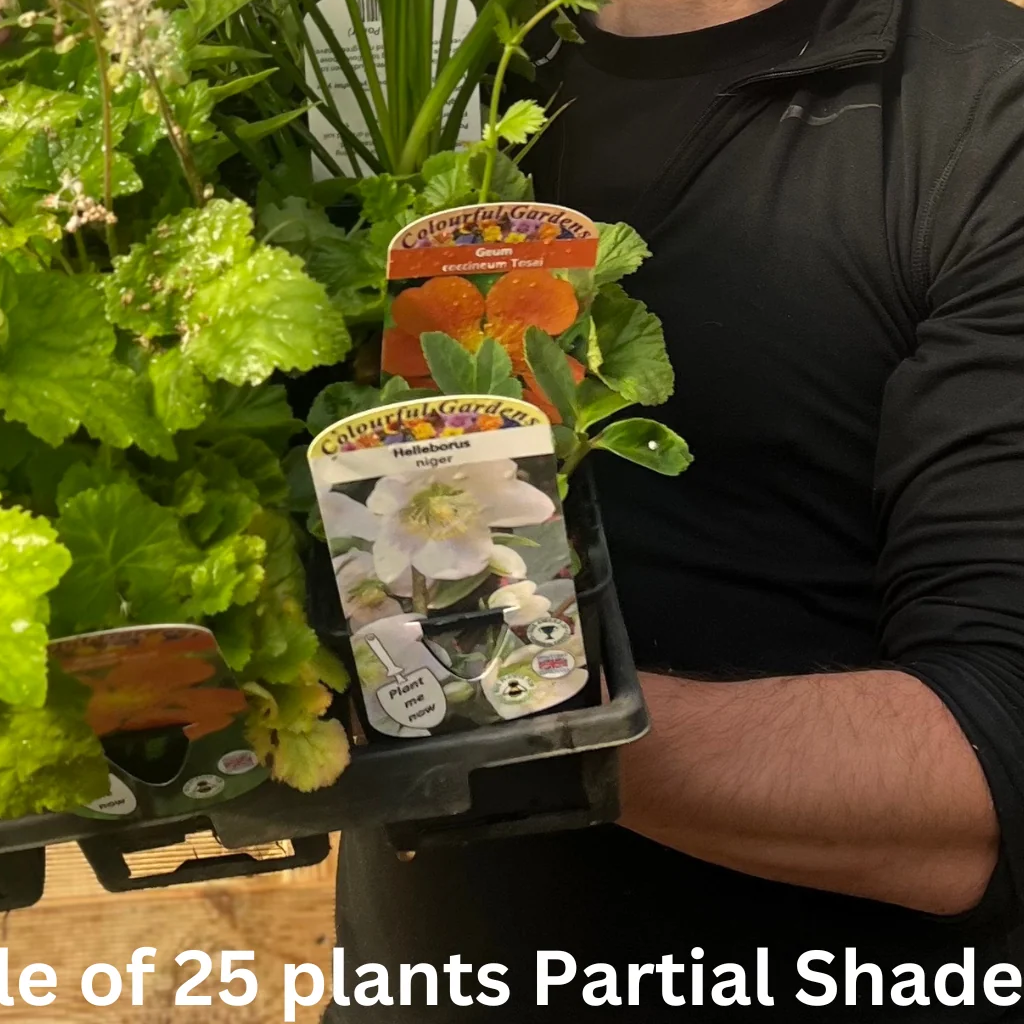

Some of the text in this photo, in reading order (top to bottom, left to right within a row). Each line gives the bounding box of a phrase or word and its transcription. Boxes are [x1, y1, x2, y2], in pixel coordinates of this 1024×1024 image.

[402, 205, 592, 249] Colourful Gardens
[475, 246, 513, 258] Geum
[442, 260, 507, 273] coccineum
[321, 400, 540, 456] Colourful Gardens
[393, 439, 471, 458] Helleborus
[416, 454, 454, 468] niger
[388, 677, 425, 701] Plant
[404, 694, 425, 709] me
[408, 703, 436, 723] now
